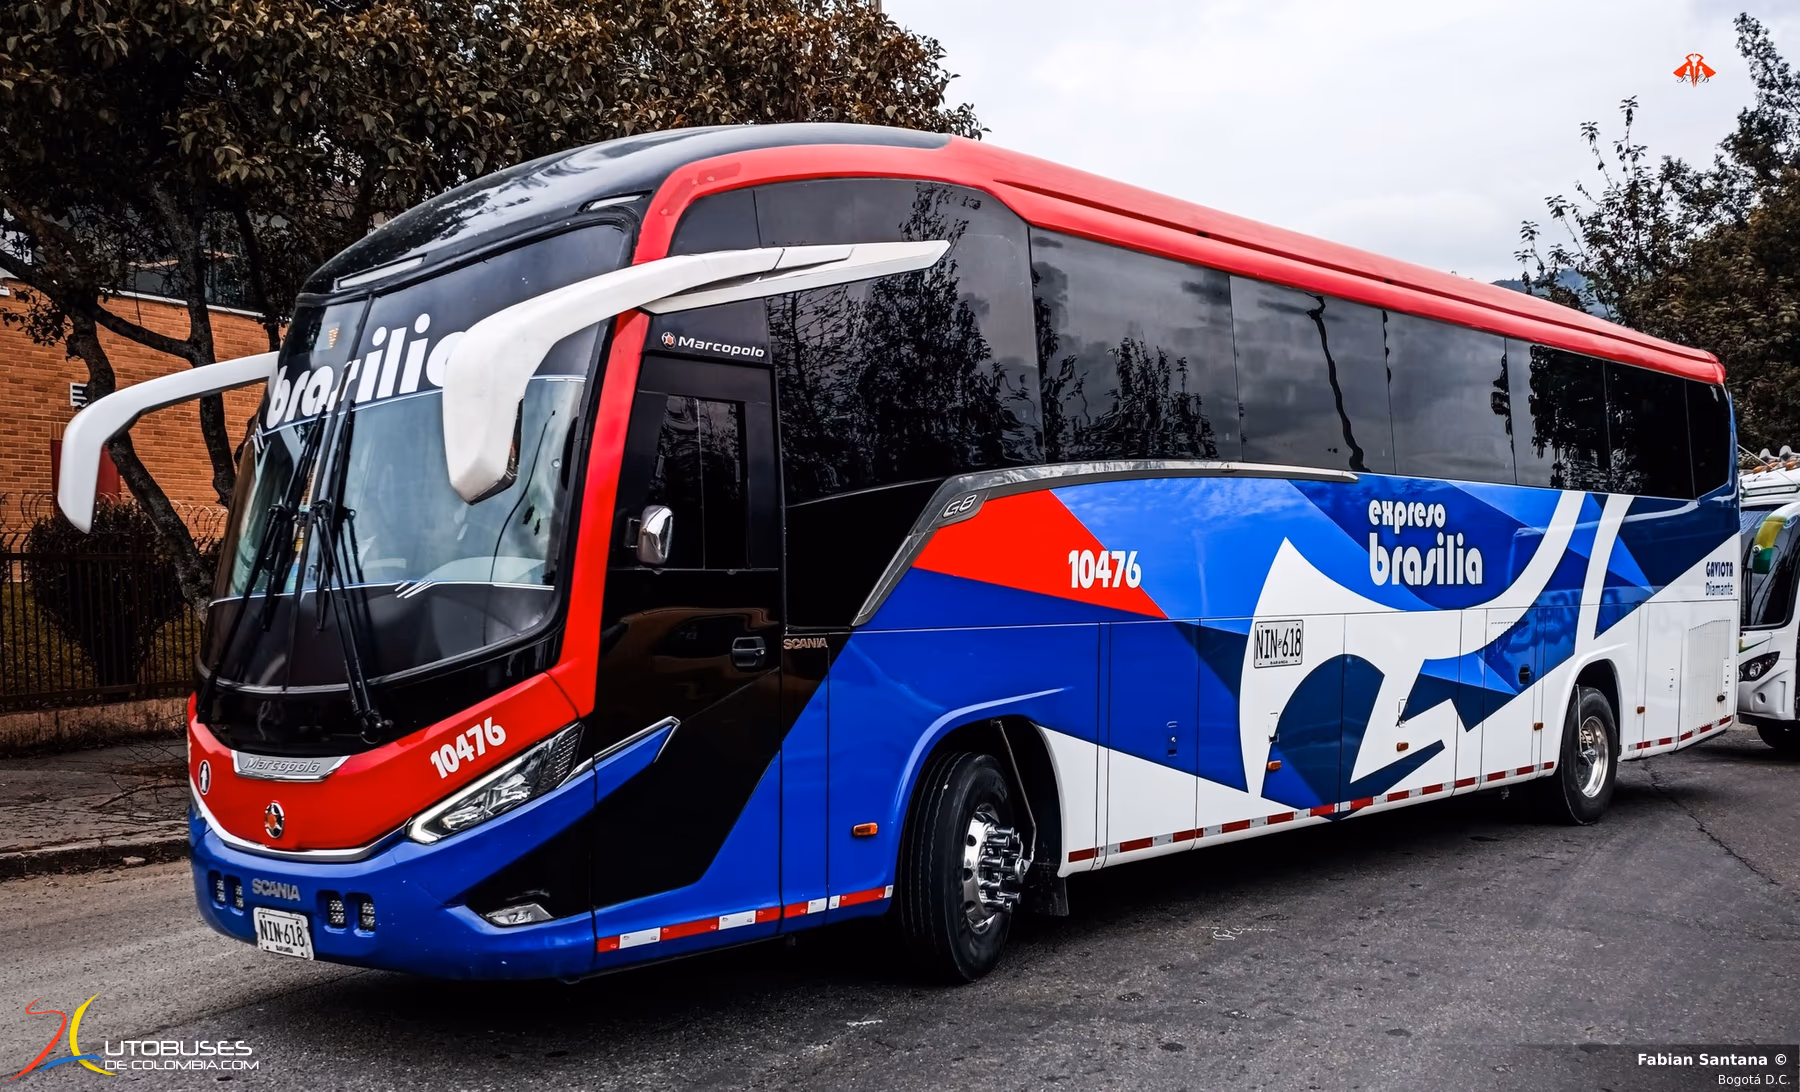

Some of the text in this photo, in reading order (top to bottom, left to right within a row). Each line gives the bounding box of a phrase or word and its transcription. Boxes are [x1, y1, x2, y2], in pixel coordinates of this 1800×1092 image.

[678, 336, 765, 358] Marcopolo
[943, 494, 977, 517] G8
[1368, 499, 1446, 534] expreso
[1068, 549, 1142, 589] 10476
[1369, 531, 1483, 586] brasilia
[1706, 561, 1733, 577] GAVIOTA
[1706, 581, 1733, 596] Diamante
[783, 637, 828, 650] SCANIA
[430, 716, 506, 779] 10476
[244, 756, 321, 774] Marcopolo
[252, 878, 300, 901] SCANIA
